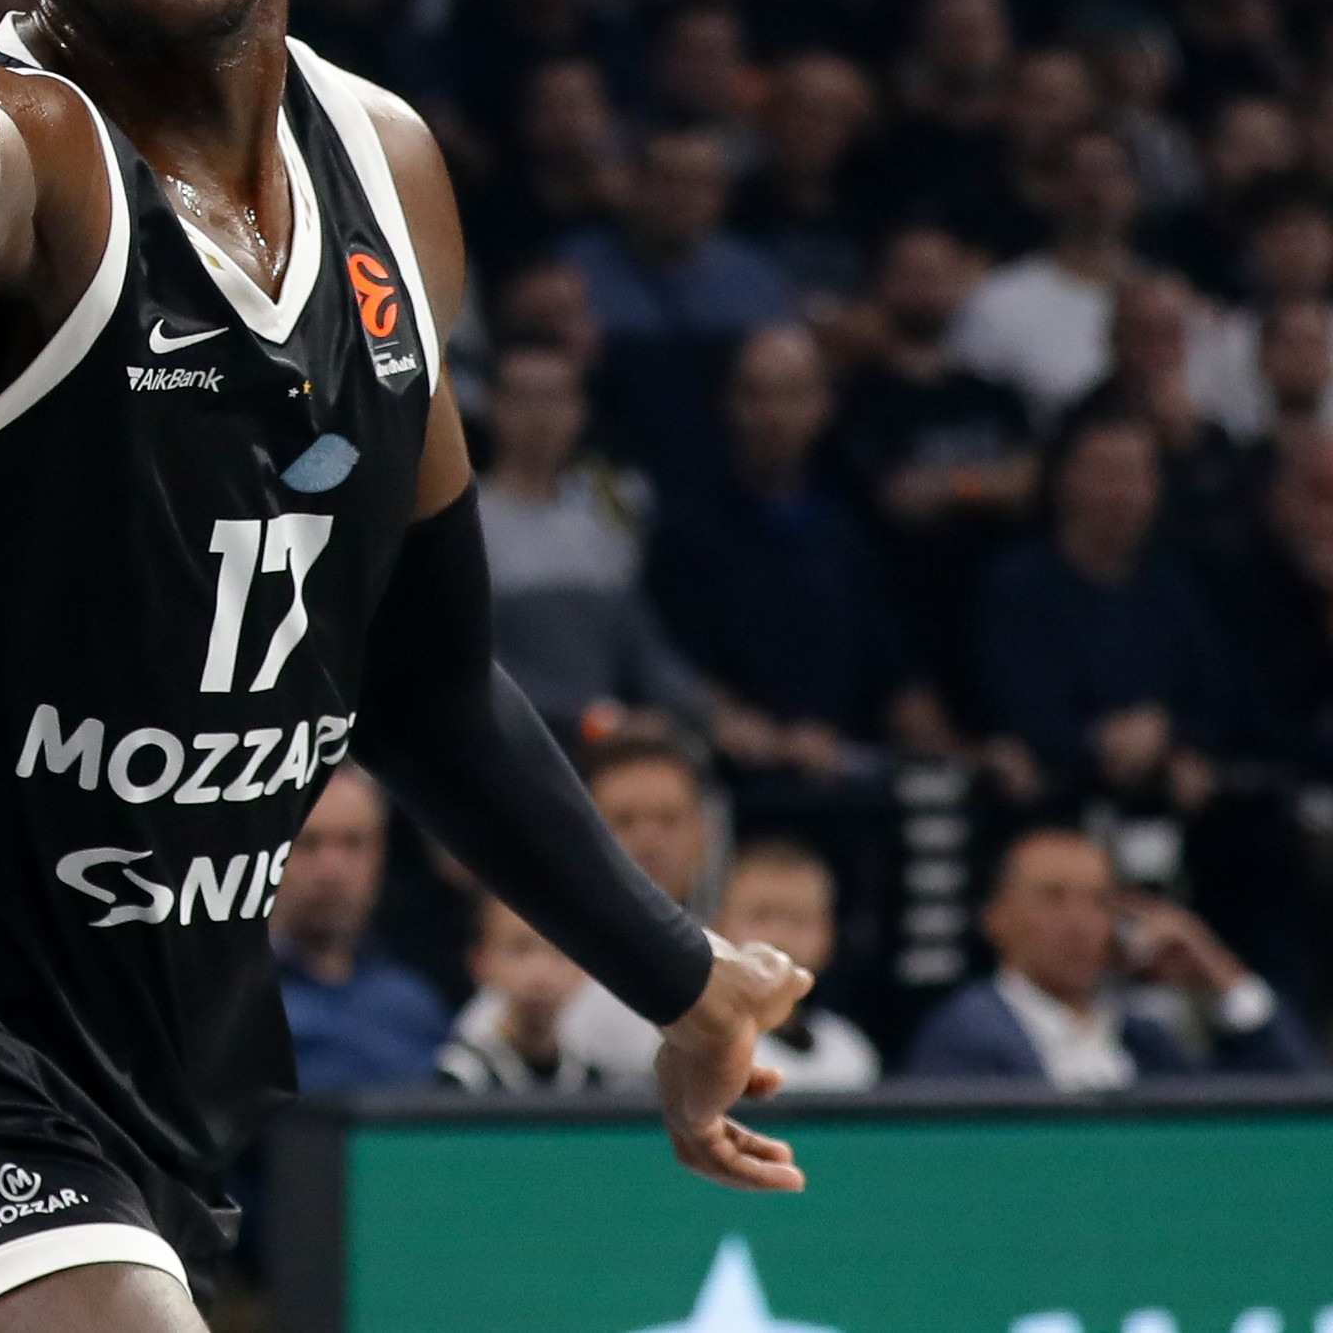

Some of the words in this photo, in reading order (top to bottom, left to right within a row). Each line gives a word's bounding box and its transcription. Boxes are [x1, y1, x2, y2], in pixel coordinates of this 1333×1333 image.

[137, 367, 225, 393] AikBank
[200, 514, 333, 693] 17
[15, 703, 356, 805] MOZZAR
